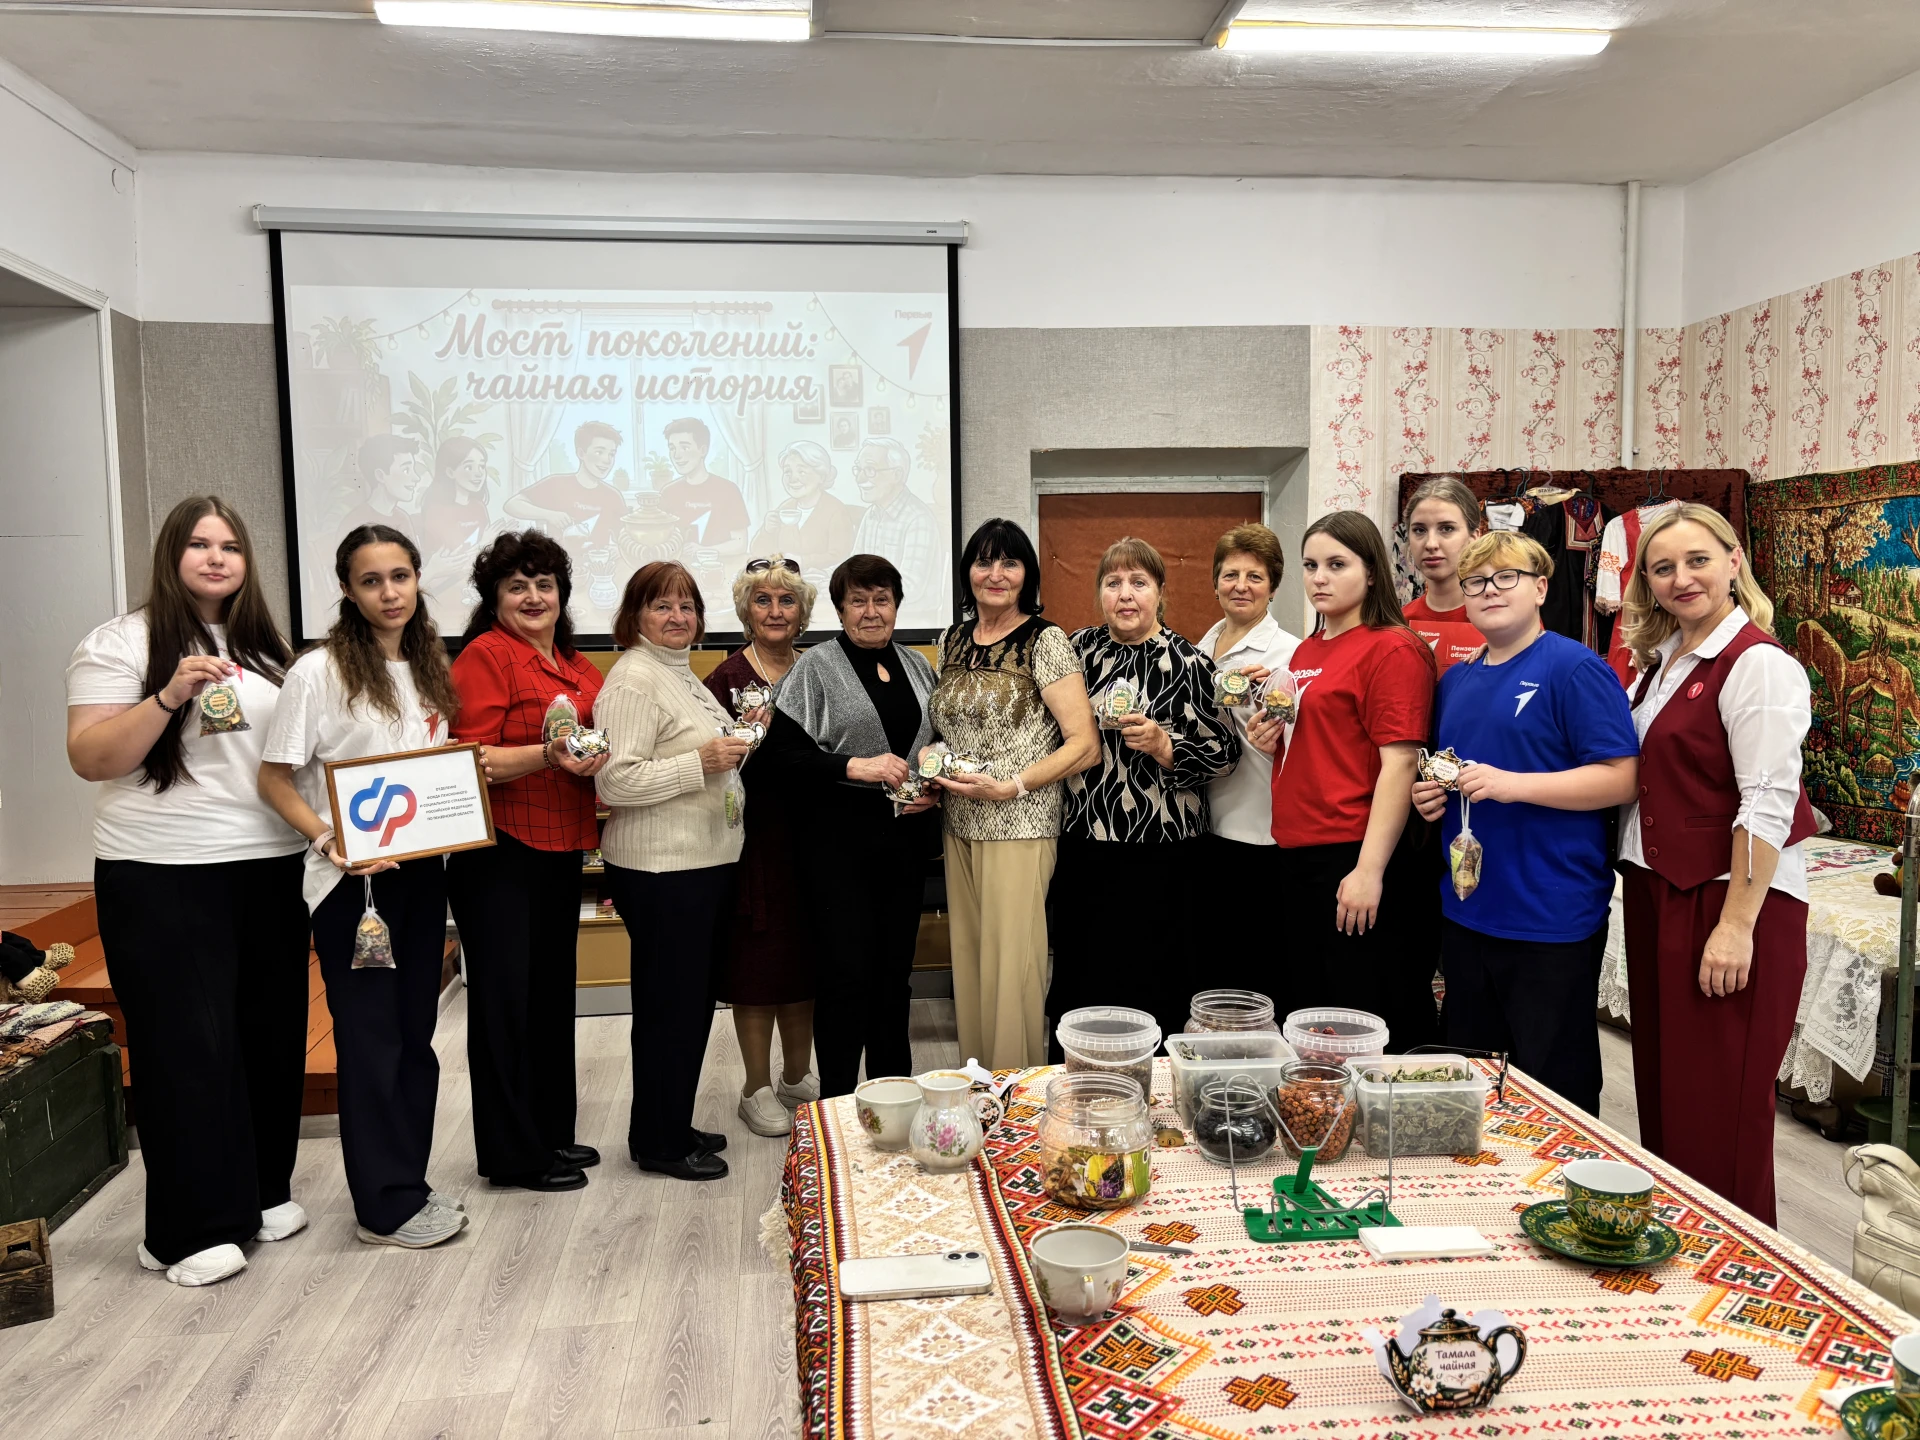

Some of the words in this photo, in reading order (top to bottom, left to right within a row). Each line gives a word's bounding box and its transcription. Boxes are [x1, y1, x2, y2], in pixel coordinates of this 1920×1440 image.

[894, 309, 933, 321] Первые
[434, 313, 573, 359] Мост
[586, 321, 819, 358] поколений:
[465, 363, 623, 401] чайная
[634, 366, 818, 417] история
[1418, 630, 1440, 638] Первые
[1293, 668, 1323, 680] ервые
[1519, 680, 1540, 688] Первые
[1435, 1350, 1475, 1359] Тамала
[1439, 1360, 1475, 1371] чайная
